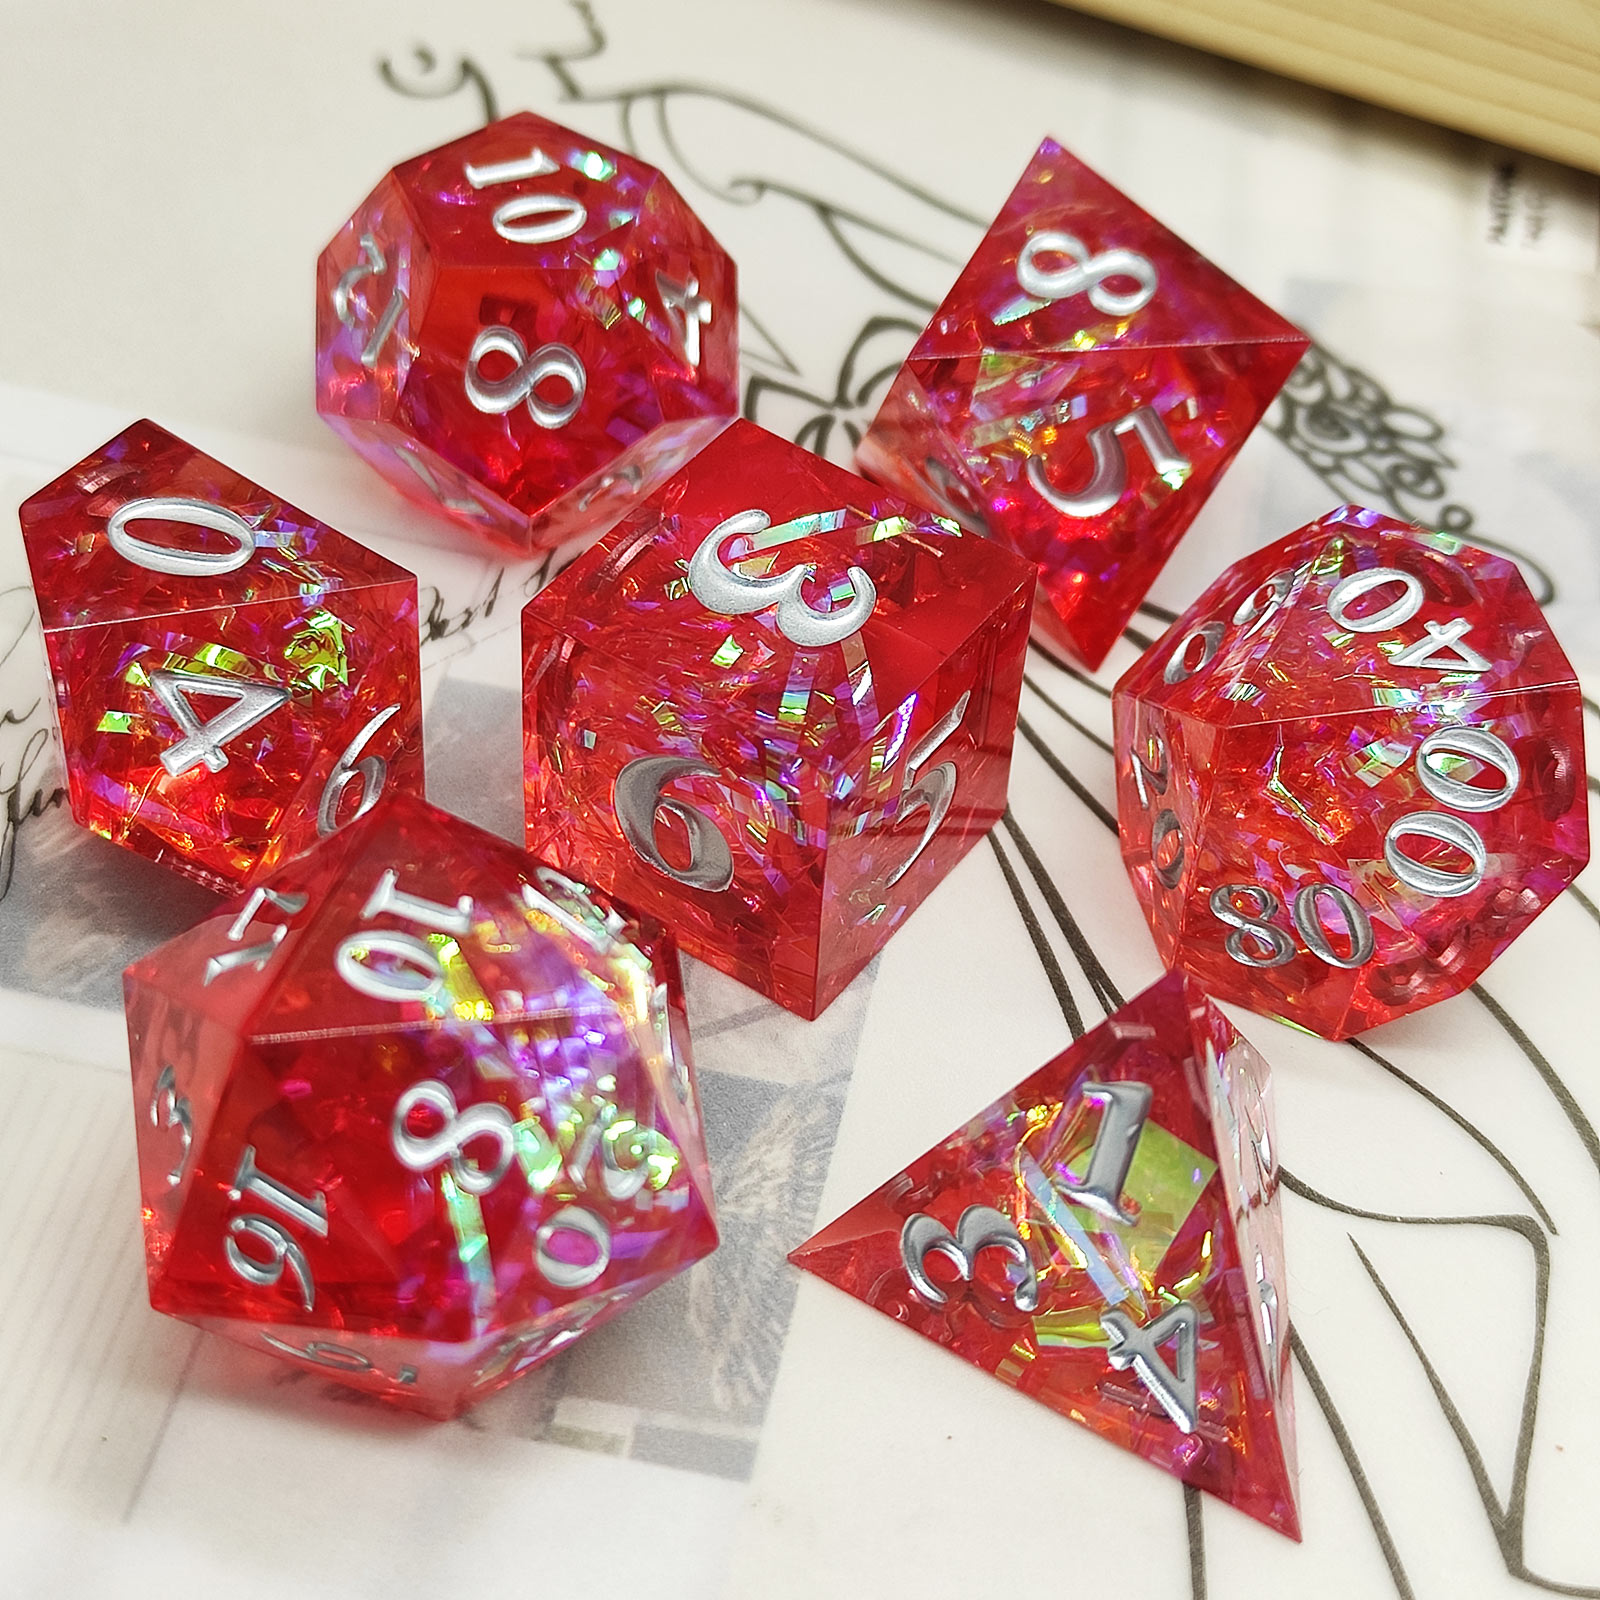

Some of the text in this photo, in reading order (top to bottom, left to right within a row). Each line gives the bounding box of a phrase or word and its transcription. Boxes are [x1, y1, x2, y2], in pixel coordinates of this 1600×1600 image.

[464, 148, 588, 243] 10
[655, 270, 713, 367] 4
[1016, 231, 1157, 316] 8
[464, 324, 587, 429] 8
[1026, 405, 1191, 518] 5
[107, 497, 256, 577] 0
[688, 509, 877, 647] 3
[1327, 567, 1492, 672] 40
[150, 669, 292, 778] 4
[614, 755, 735, 891] 6
[884, 690, 970, 890] 5
[203, 886, 309, 987] 17
[335, 868, 474, 1001] 10
[1209, 882, 1376, 969] 80
[150, 1063, 193, 1187] 3
[392, 1079, 516, 1195] 8
[1056, 1080, 1154, 1227] 1
[223, 1144, 329, 1312] 16
[900, 1203, 1038, 1312] 3
[1101, 1303, 1200, 1434] 4
